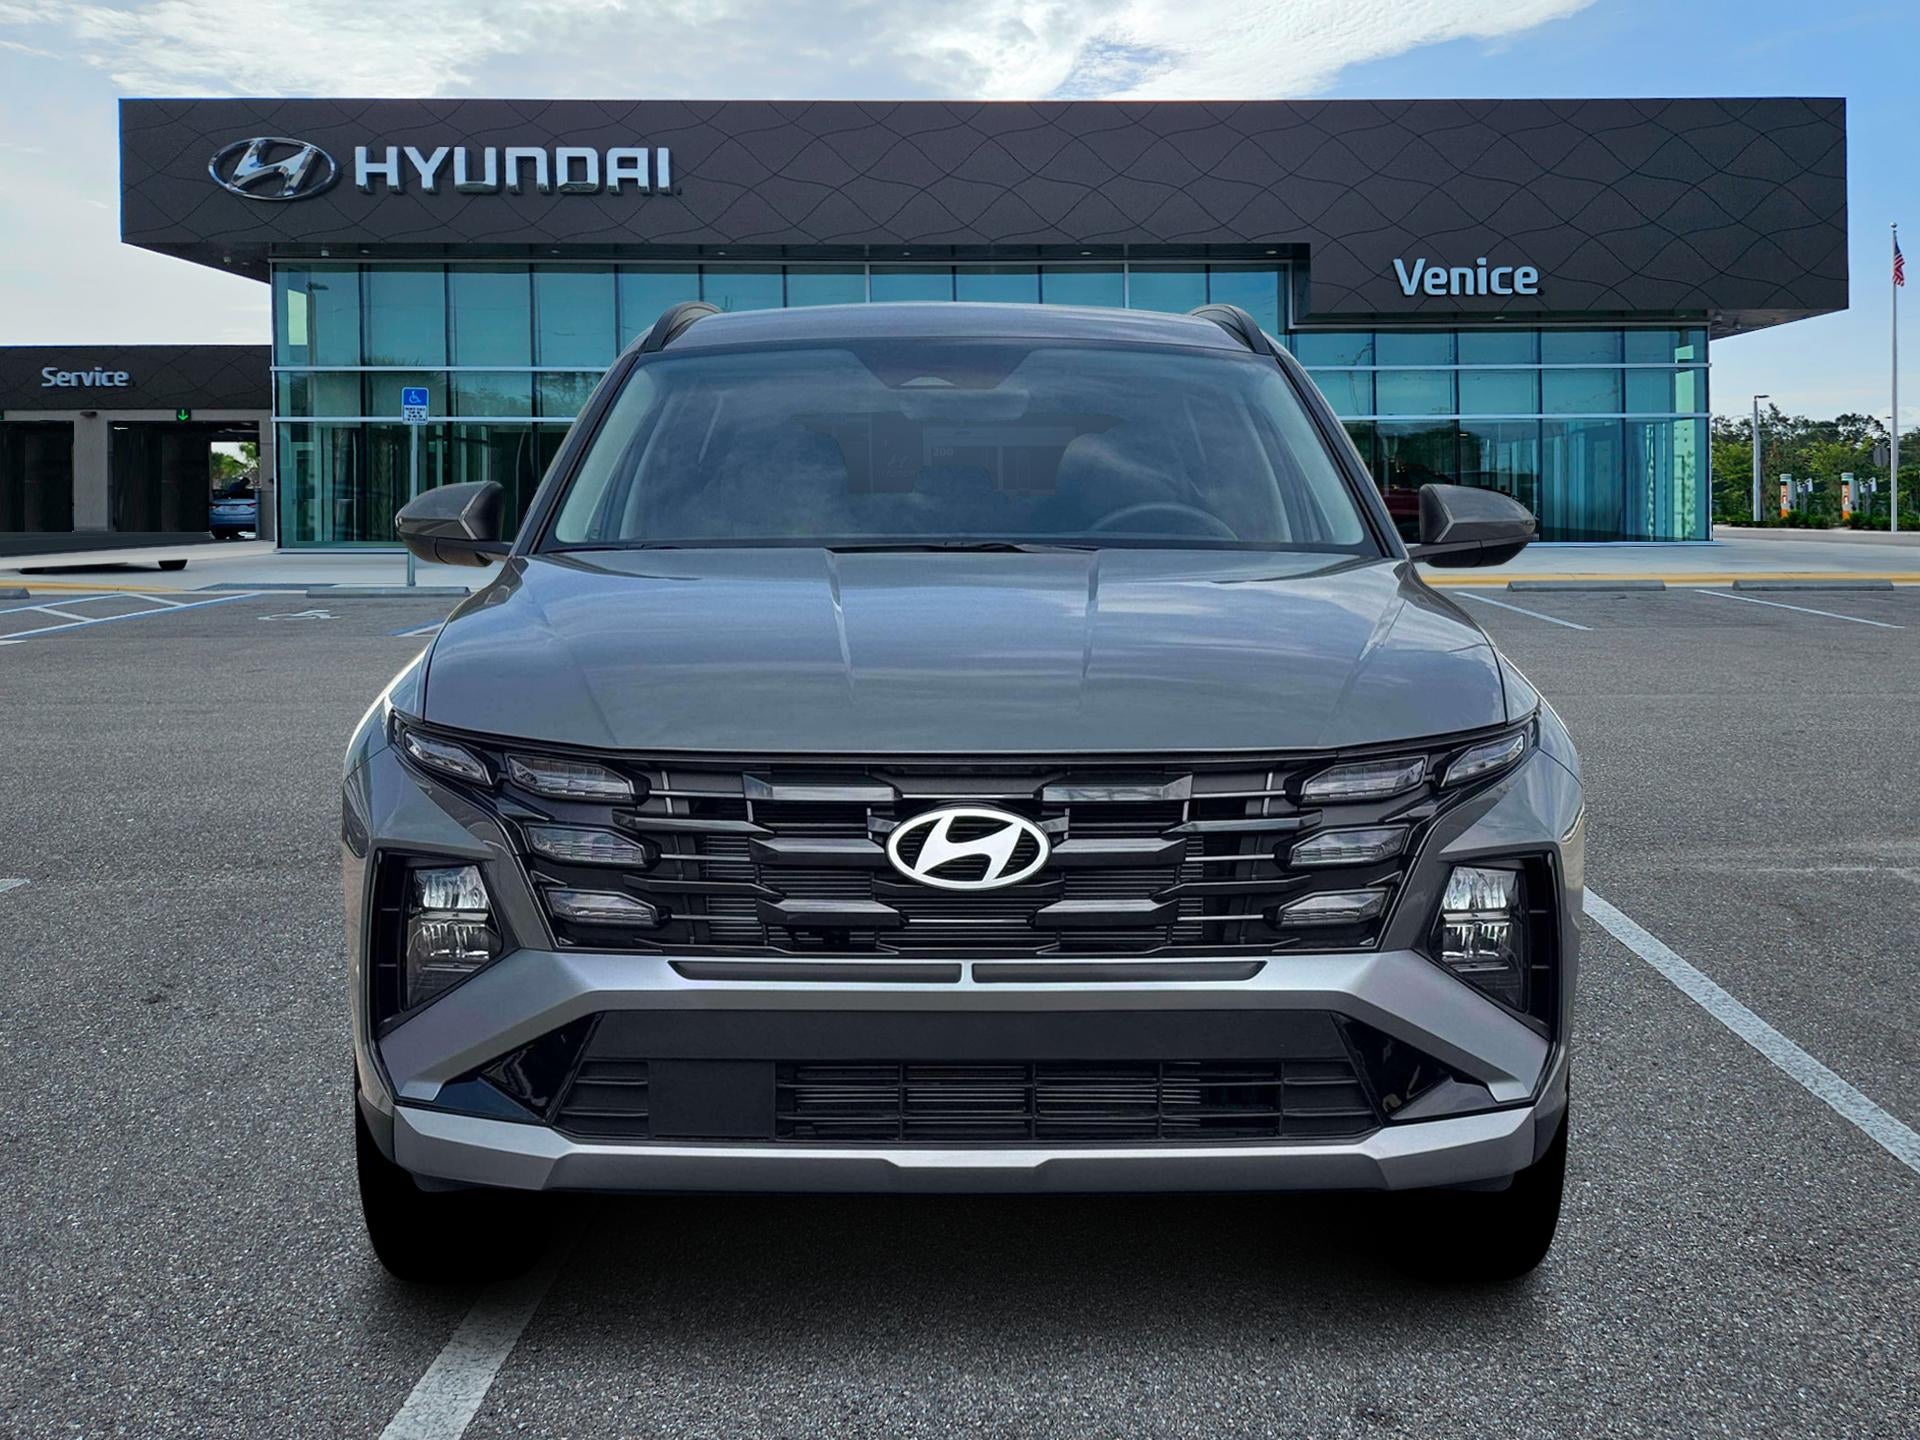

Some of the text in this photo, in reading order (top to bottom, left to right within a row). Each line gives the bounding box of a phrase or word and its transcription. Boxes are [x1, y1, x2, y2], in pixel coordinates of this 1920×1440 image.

[354, 145, 671, 194] HYUNDAI
[1392, 256, 1539, 296] Venice
[41, 366, 129, 387] Service
